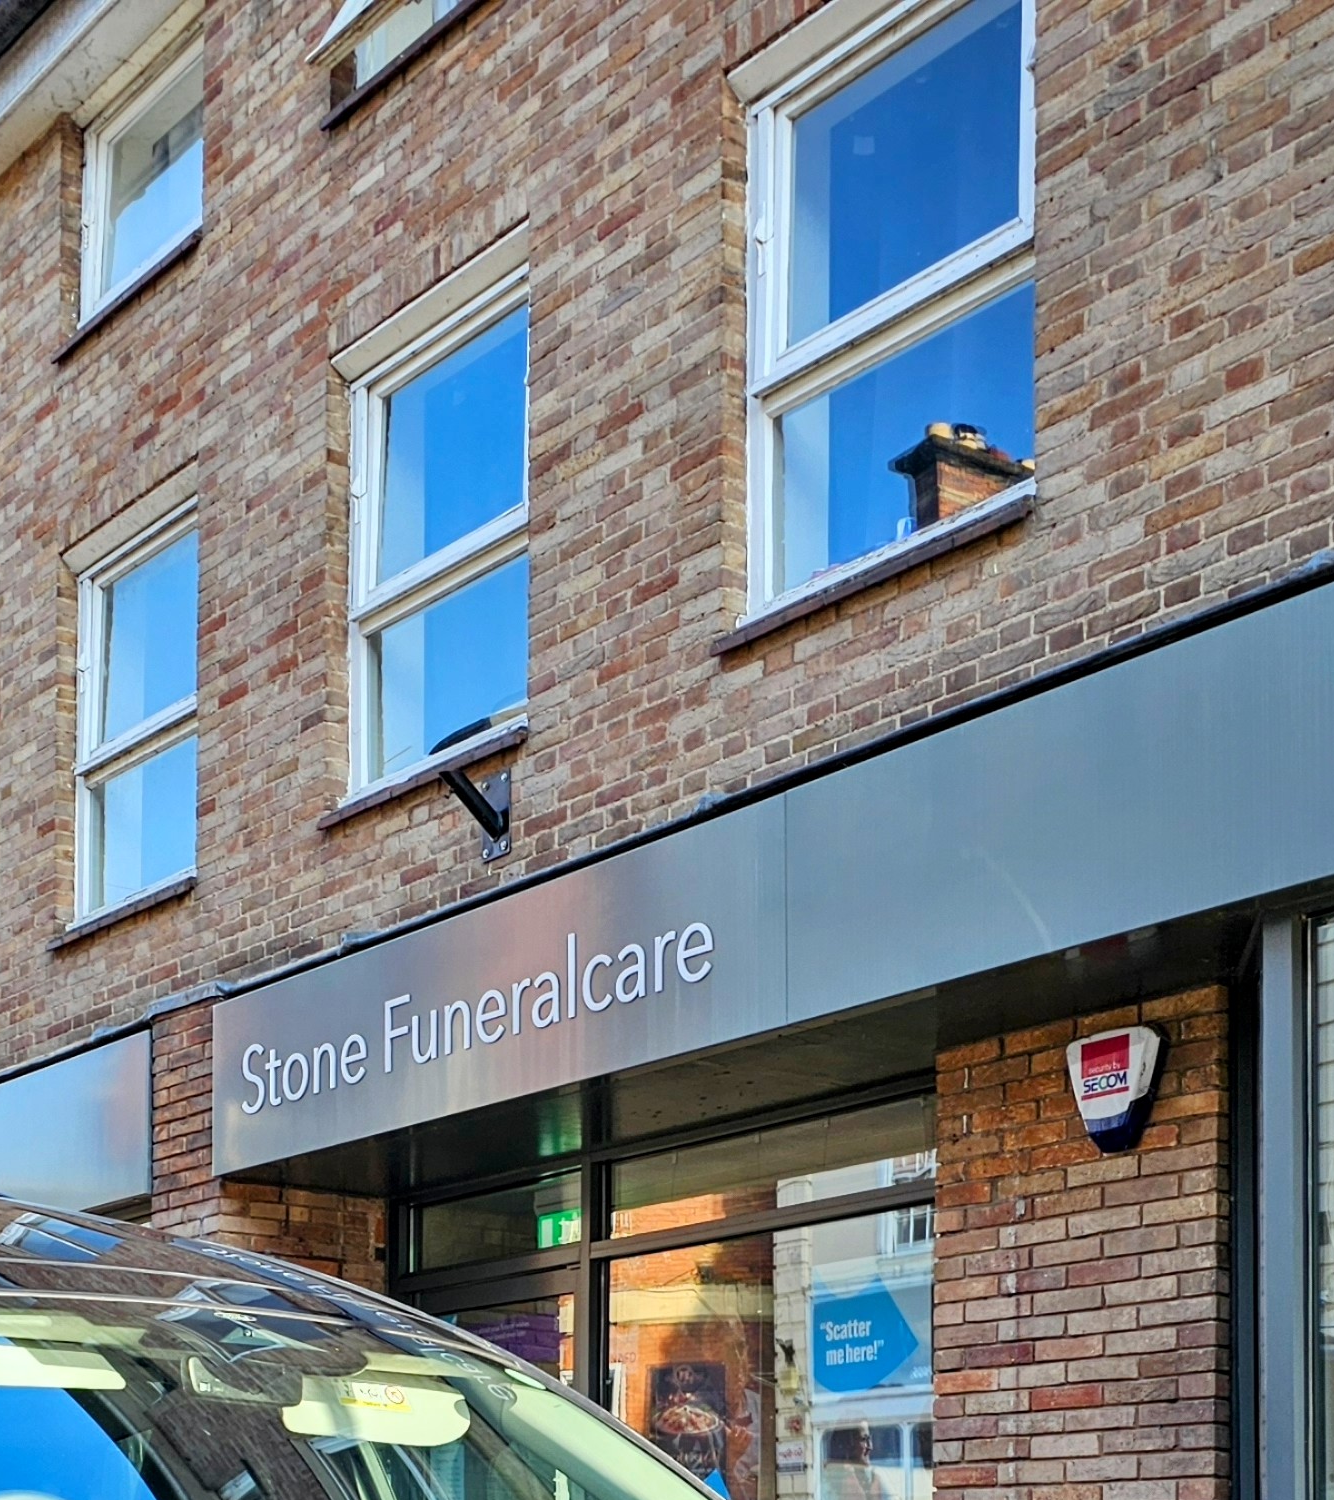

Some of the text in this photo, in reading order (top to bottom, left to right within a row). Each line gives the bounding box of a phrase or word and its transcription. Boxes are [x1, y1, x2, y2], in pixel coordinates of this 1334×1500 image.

[241, 921, 714, 1115] Stone Funeralcare
[1112, 1061, 1121, 1071] by
[1083, 1071, 1127, 1094] SECOM
[826, 1348, 844, 1366] me
